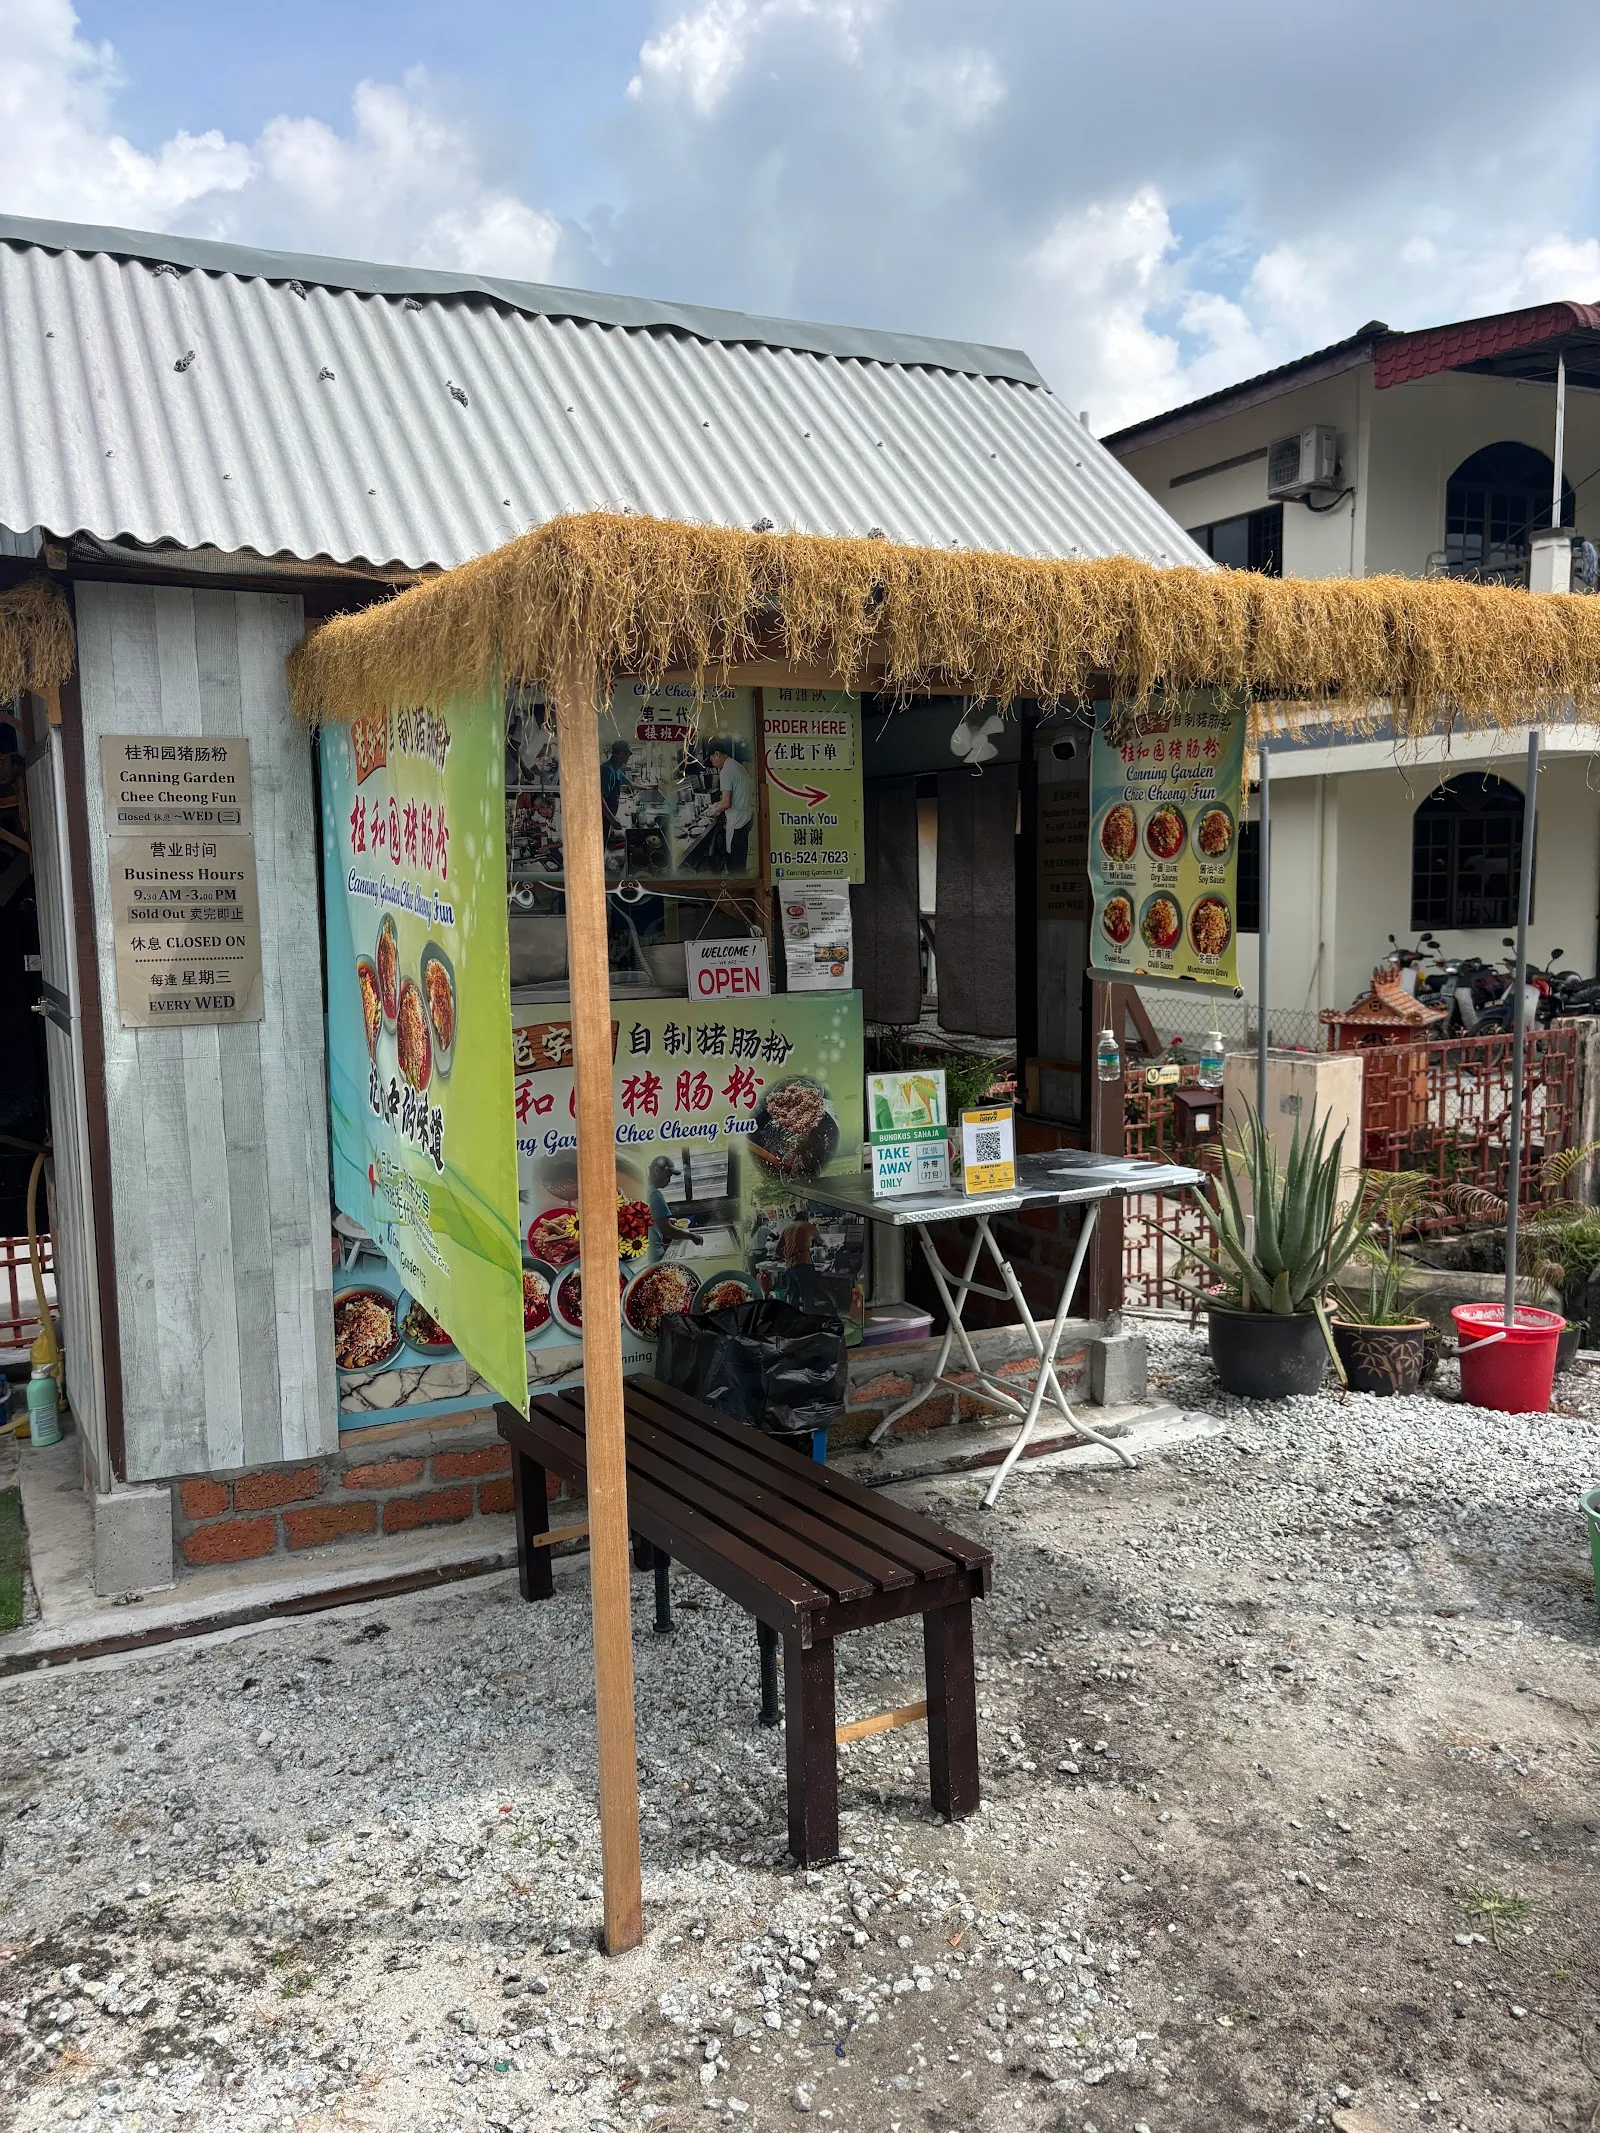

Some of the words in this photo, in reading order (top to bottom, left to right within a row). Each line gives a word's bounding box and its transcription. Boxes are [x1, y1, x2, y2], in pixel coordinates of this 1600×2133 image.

[640, 705, 690, 723] 第二代
[644, 725, 688, 740] 接班人
[764, 720, 808, 734] ORDER
[812, 720, 847, 735] HERE
[125, 744, 228, 762] 桂和园猪肠粉
[774, 743, 837, 760] 在此下单
[1120, 736, 1221, 763] 桂和园猪肠粉
[120, 771, 180, 785] Canning
[183, 772, 236, 784] Garden
[1126, 765, 1168, 785] Canning
[1171, 762, 1214, 784] Garden
[121, 791, 154, 802] Chee
[158, 791, 208, 805] Cheong
[211, 791, 236, 803] Fun
[1124, 785, 1144, 801] Chee
[1148, 784, 1187, 805] Cheong
[1190, 783, 1215, 800] Fun
[117, 812, 150, 821] Closed
[154, 813, 170, 821] 休息
[779, 813, 815, 824] Thank
[817, 813, 838, 824] You
[350, 794, 449, 880] 桂和园猪肠粉
[794, 828, 824, 845] 谢谢
[150, 842, 217, 858] 营业时间
[770, 851, 818, 864] 016-524
[820, 851, 848, 863] 7623
[124, 868, 194, 880] Business
[198, 868, 244, 880] Hours
[786, 869, 811, 877] Canning
[811, 868, 833, 877] Garden
[1198, 875, 1208, 885] Soy
[1209, 876, 1226, 885] Sauce
[133, 889, 157, 900] 9.30
[159, 889, 181, 900] AM
[215, 889, 236, 900] PM
[348, 867, 379, 906] Canning
[433, 891, 454, 924] Fun
[131, 908, 159, 919] Sold
[162, 908, 185, 919] Out
[190, 908, 244, 921] 卖完即止
[130, 937, 162, 951] 休息
[166, 936, 221, 948] CLOSED
[225, 935, 246, 946] ON
[701, 945, 750, 958] WELCOME
[1117, 956, 1130, 965] Sauce
[1160, 961, 1174, 970] Sauce
[150, 973, 178, 987] 每逢
[181, 969, 232, 986] 星期三
[1187, 965, 1215, 976] Mushroom
[1215, 968, 1229, 979] Gravy
[698, 966, 760, 995] OPEN
[149, 1000, 191, 1011] EVERY
[194, 995, 235, 1009] WED
[628, 1021, 794, 1065] 自制猪肠粉
[615, 1123, 654, 1143] Chee
[660, 1120, 719, 1141] Cheong
[723, 1115, 757, 1134] Fun
[879, 1131, 911, 1142] BUNGKUS
[913, 1129, 940, 1139] SAHAJA
[877, 1146, 911, 1160] TAKE
[922, 1147, 938, 1155] 仅供
[879, 1160, 912, 1175] AWAY
[922, 1160, 939, 1169] 外带
[880, 1177, 903, 1188] ONLY
[621, 1351, 653, 1364] nning
